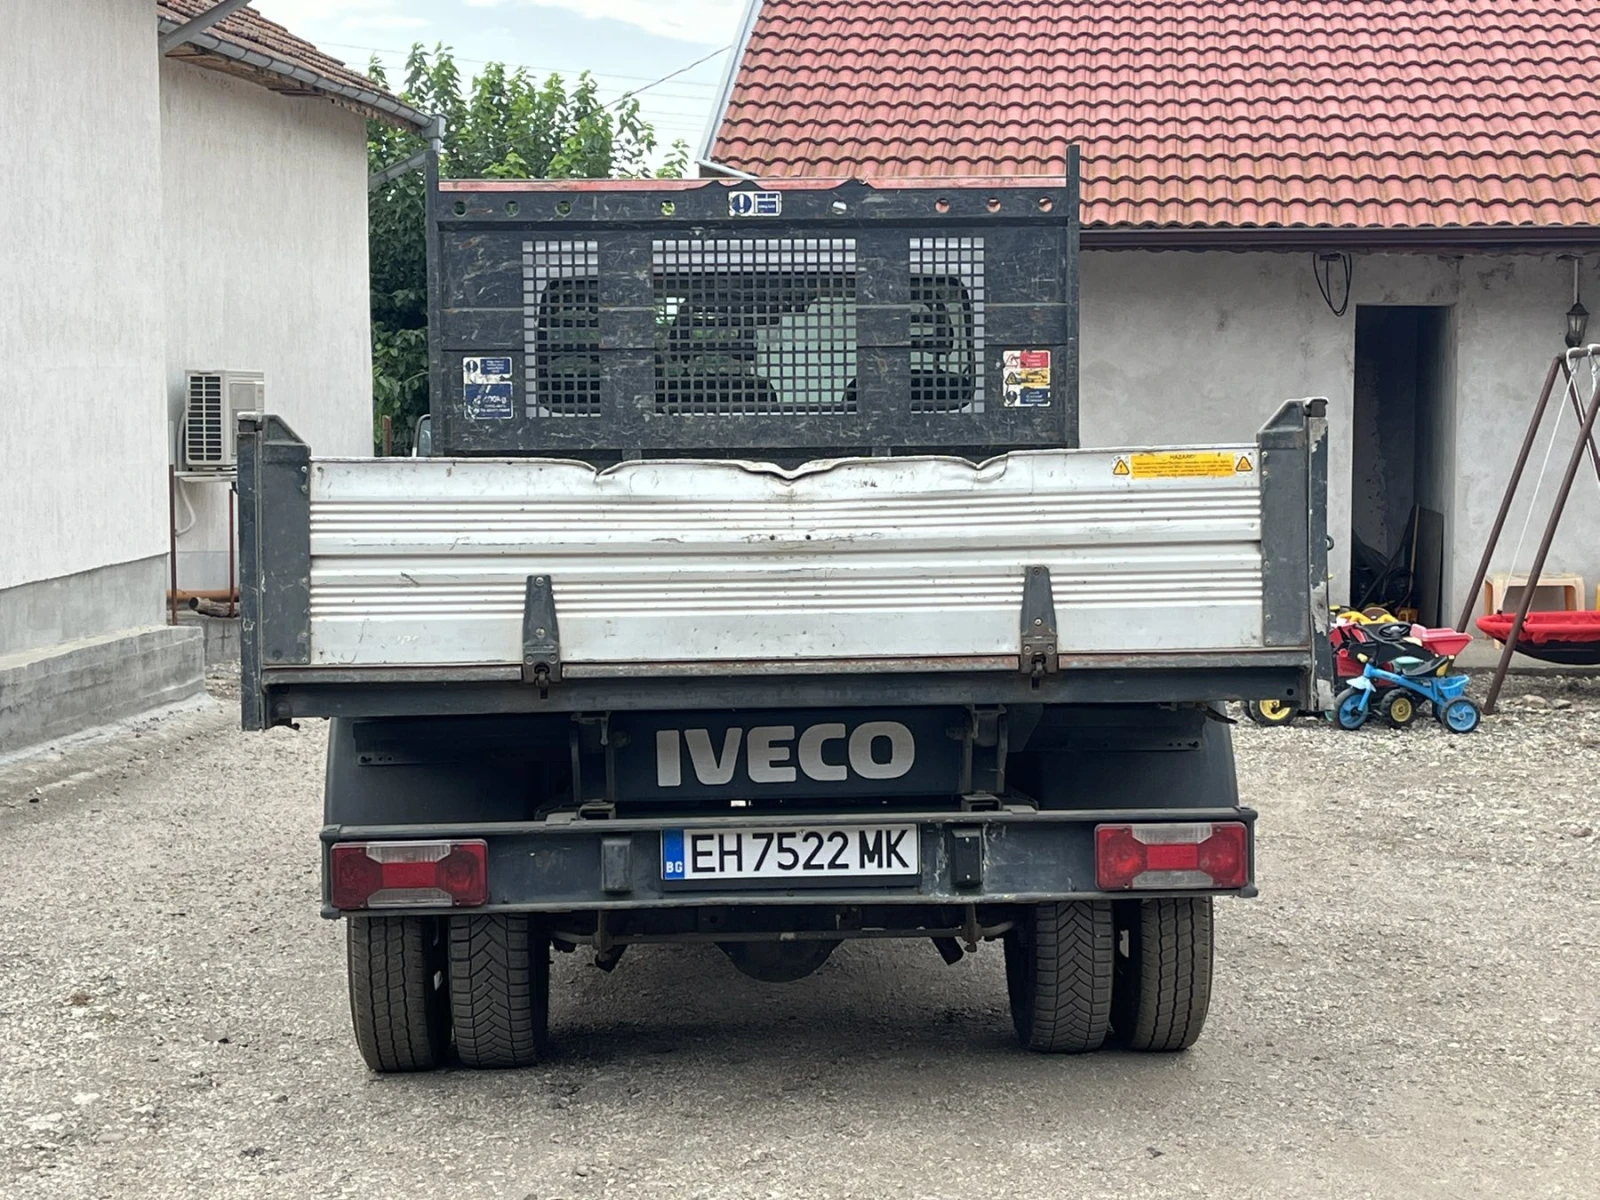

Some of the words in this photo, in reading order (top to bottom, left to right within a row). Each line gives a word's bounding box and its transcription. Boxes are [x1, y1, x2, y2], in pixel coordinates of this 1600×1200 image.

[656, 721, 915, 787] IVECO
[666, 861, 683, 873] BG
[691, 833, 743, 873] EH
[752, 831, 849, 872] 7522
[859, 829, 909, 869] MK
